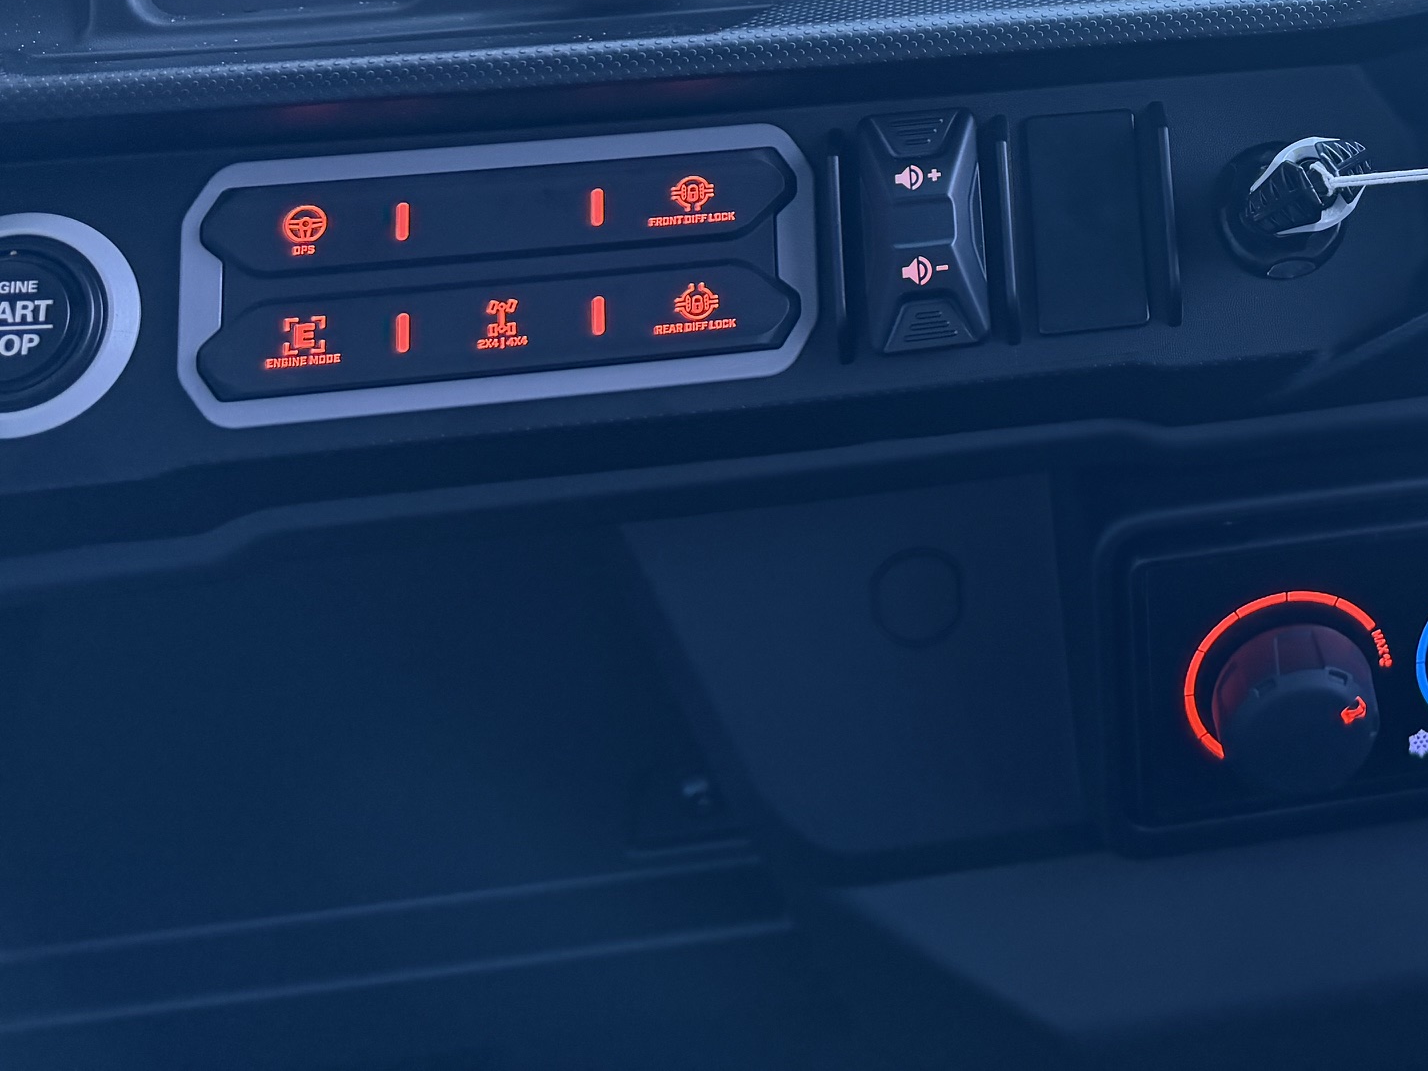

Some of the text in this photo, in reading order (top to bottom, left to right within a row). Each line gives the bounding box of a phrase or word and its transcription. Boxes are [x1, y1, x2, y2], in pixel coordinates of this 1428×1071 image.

[648, 211, 736, 228] FRONT DIFF LOCK
[653, 318, 737, 336] REAR DIFF LOCK
[265, 354, 341, 369] ENGINE MODE
[1371, 629, 1389, 657] MAX
